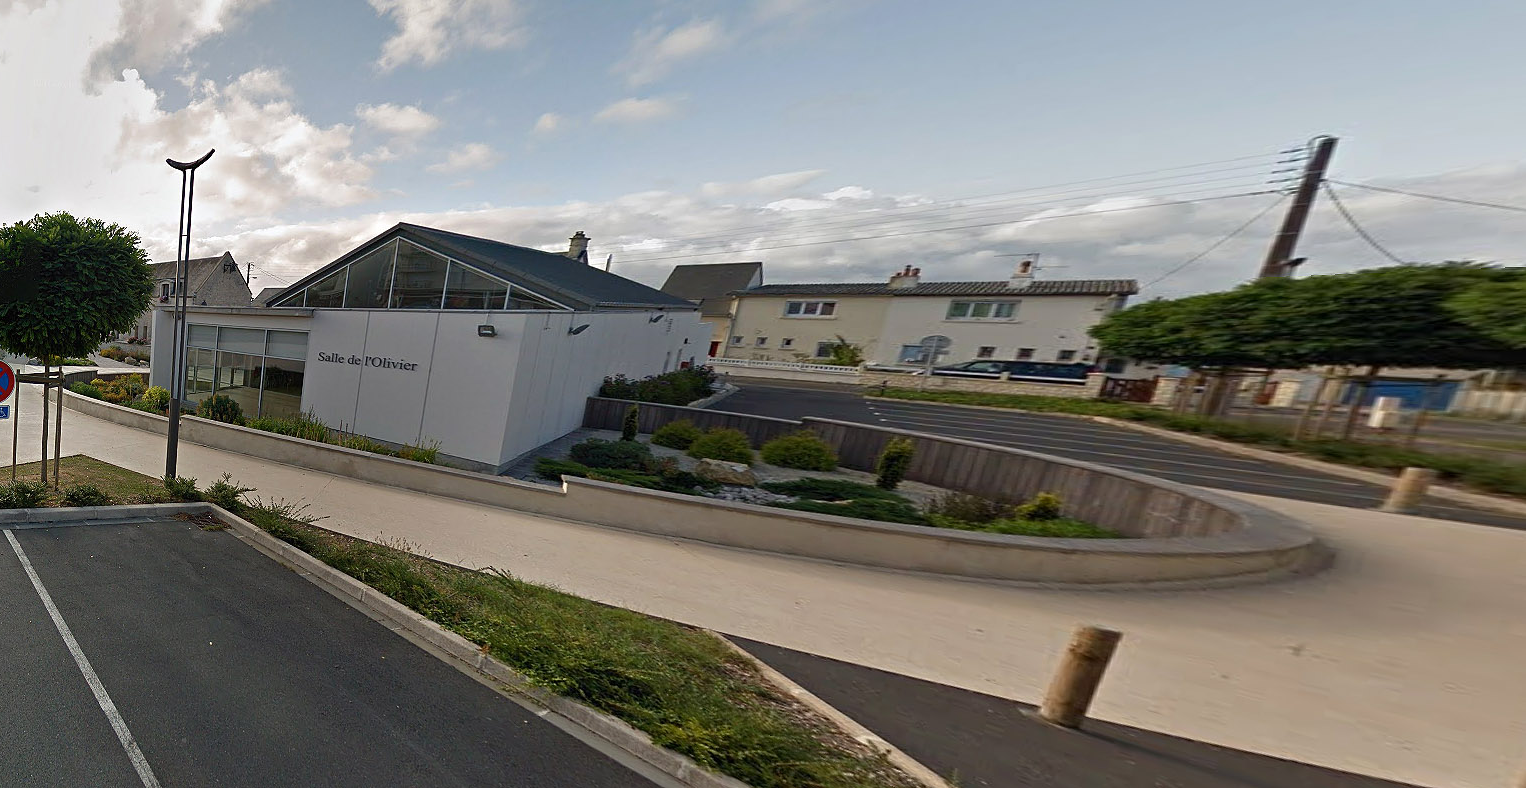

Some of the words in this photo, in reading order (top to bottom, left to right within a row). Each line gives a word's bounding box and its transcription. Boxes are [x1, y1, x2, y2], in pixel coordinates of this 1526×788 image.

[317, 351, 345, 364] Salle
[347, 354, 362, 366] de
[364, 356, 418, 372] l'Olivier
